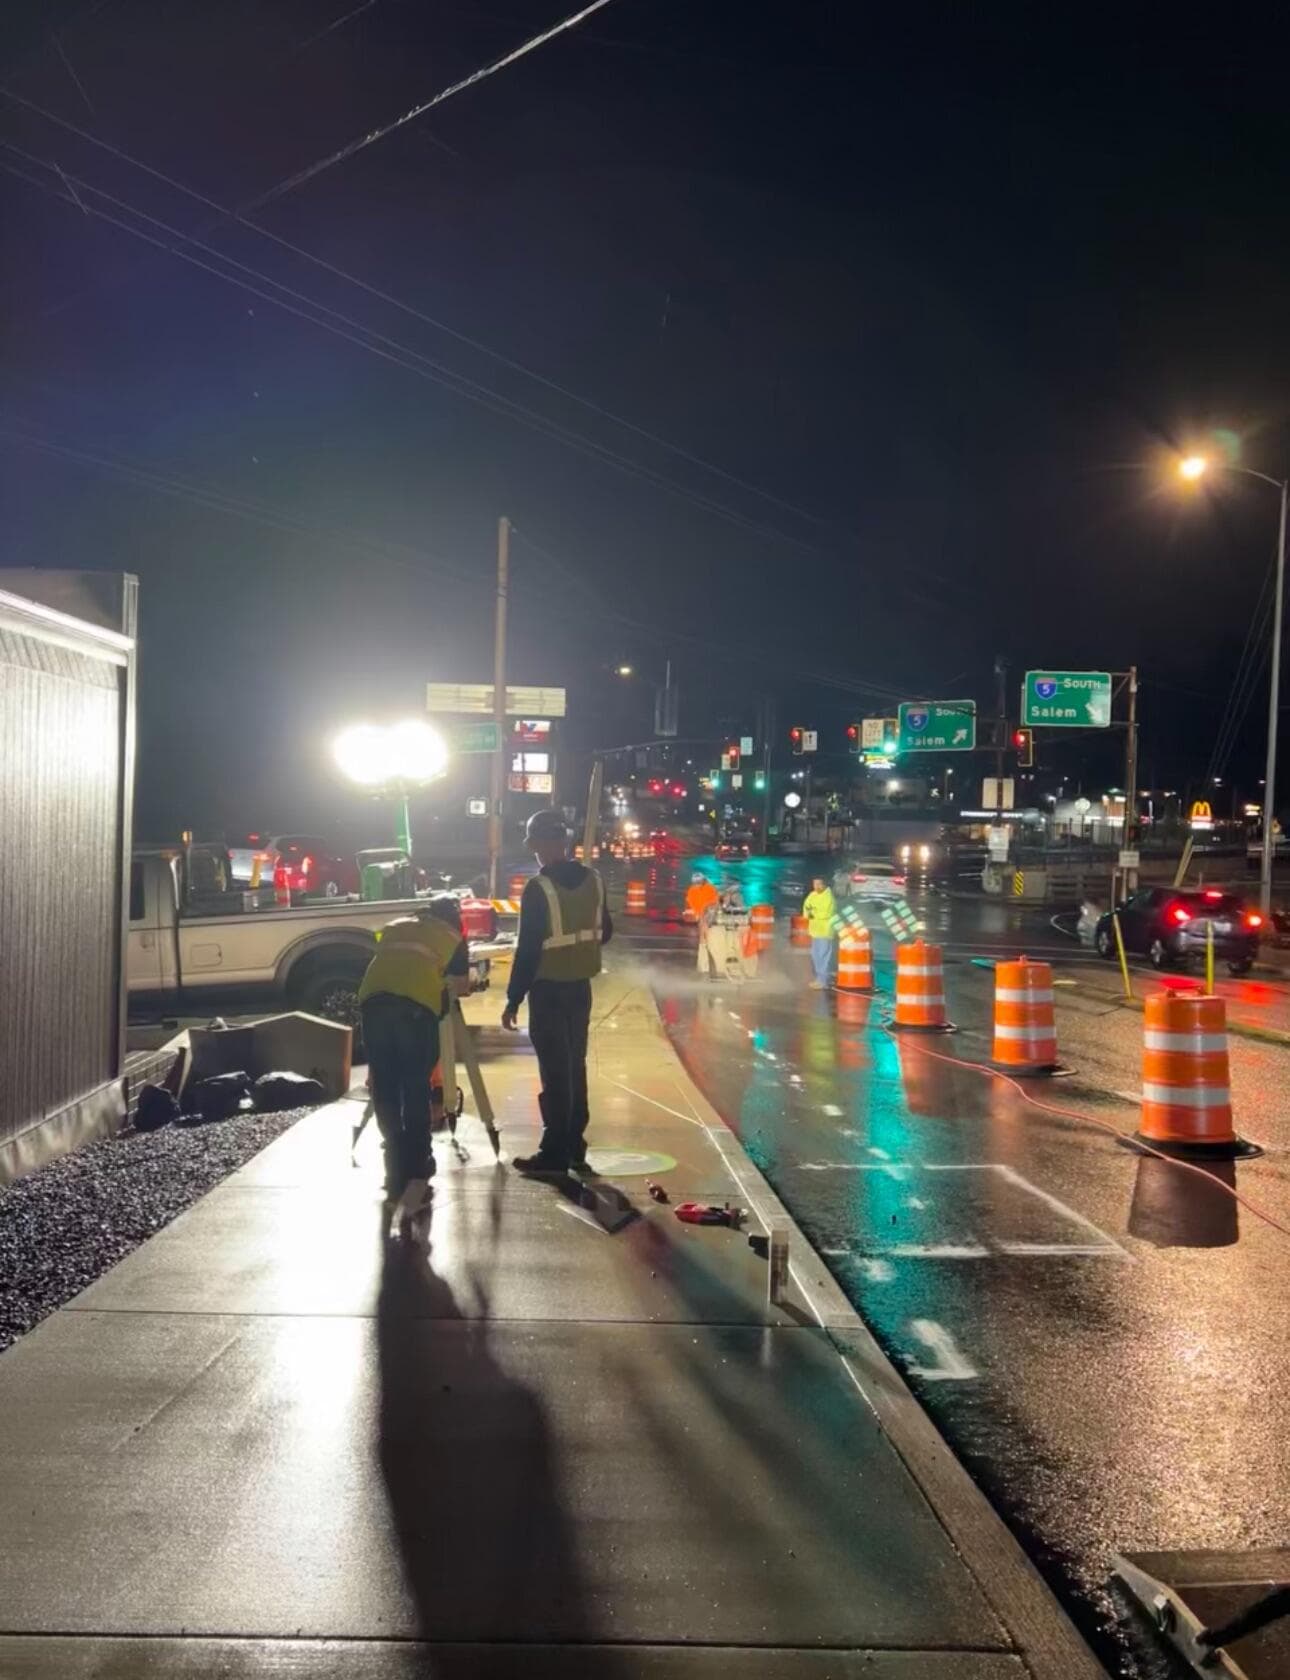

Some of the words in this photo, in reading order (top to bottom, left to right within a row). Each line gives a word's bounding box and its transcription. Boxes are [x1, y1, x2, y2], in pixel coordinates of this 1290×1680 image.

[1041, 683, 1051, 695] 5
[1063, 678, 1101, 689] SOUTH
[1031, 706, 1077, 718] Salem
[912, 717, 922, 727] 5
[906, 736, 945, 746] Salem
